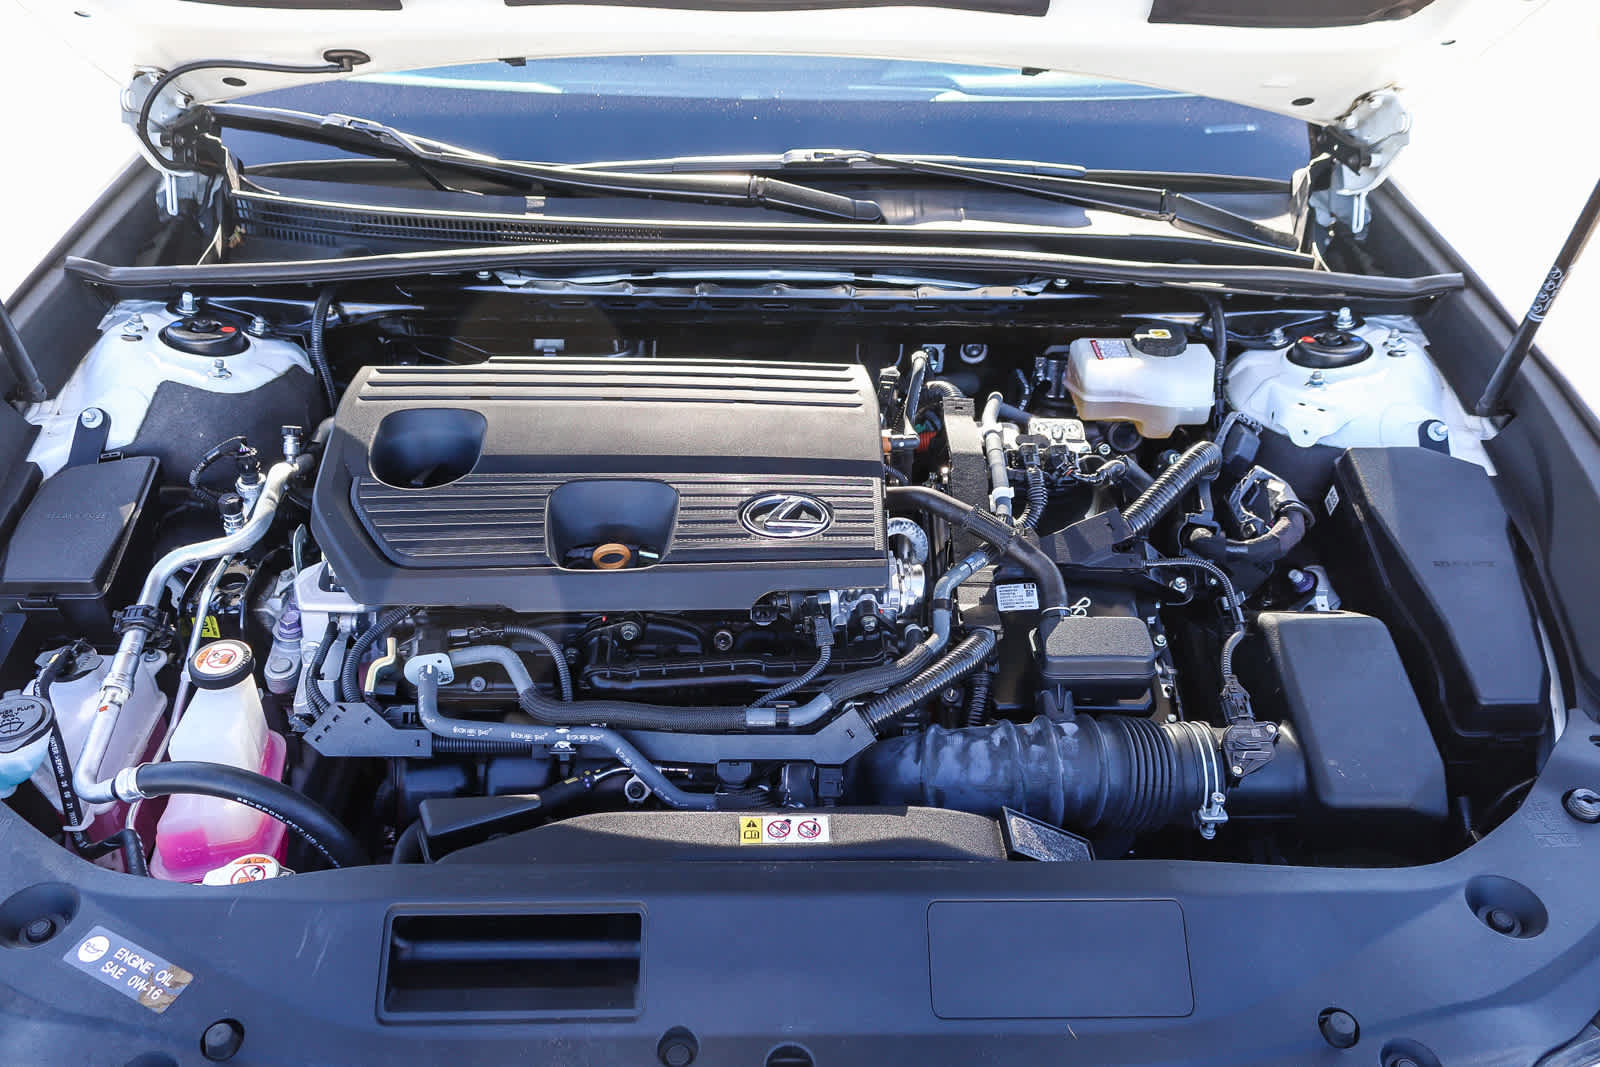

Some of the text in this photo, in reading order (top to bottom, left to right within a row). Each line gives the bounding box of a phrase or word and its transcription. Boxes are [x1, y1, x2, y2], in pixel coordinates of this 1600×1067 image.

[101, 960, 163, 1000] SAE 0W-16
[114, 947, 175, 986] ENGINE OIL
